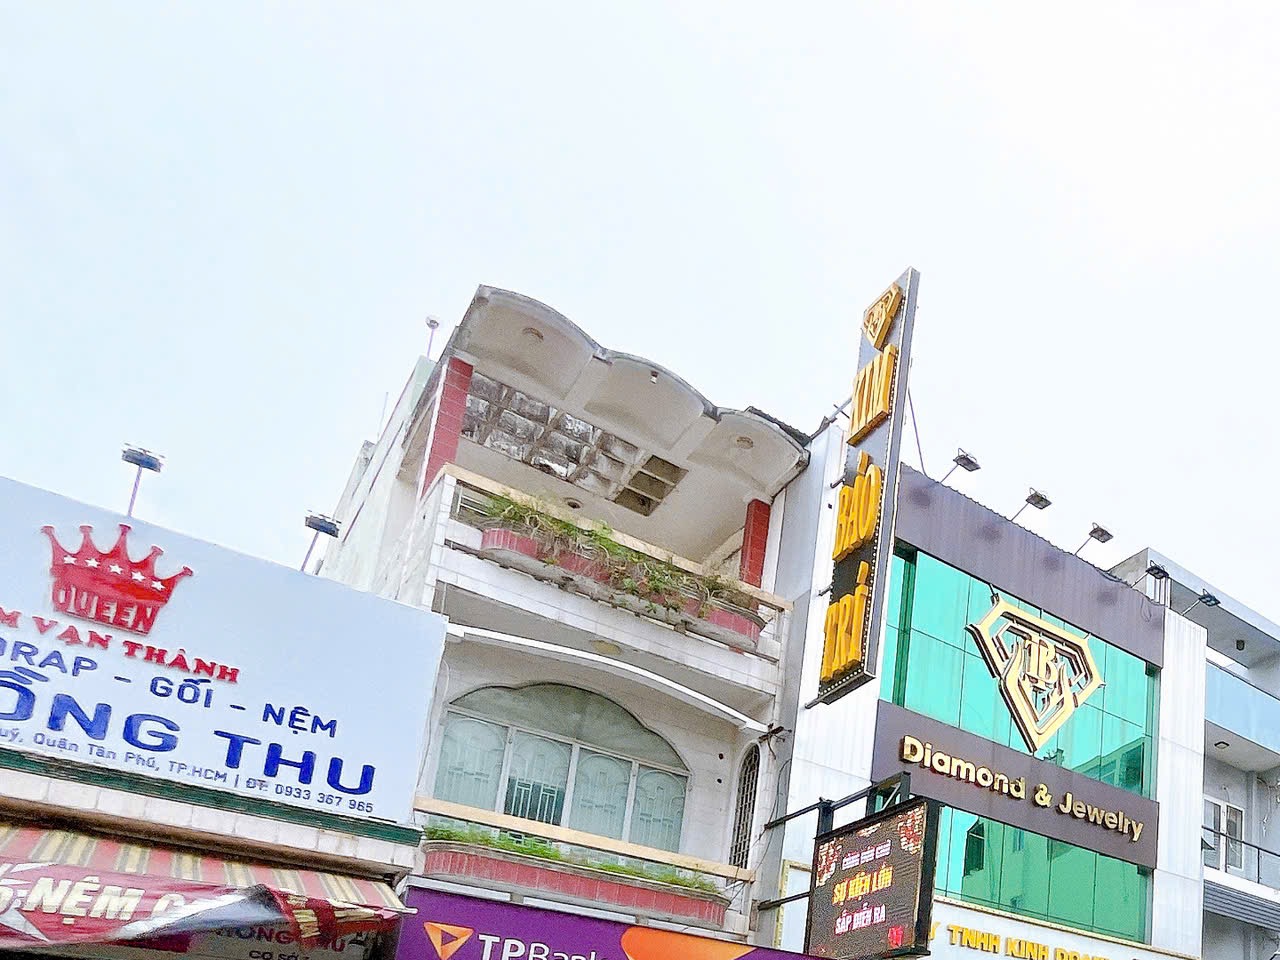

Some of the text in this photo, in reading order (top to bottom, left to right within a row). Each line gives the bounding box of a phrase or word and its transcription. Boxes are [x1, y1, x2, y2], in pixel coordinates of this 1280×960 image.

[846, 342, 900, 447] KIM
[32, 616, 112, 649] VẠN
[53, 587, 157, 636] QUEEN
[263, 703, 337, 738] NỆM
[33, 732, 78, 751] Quận
[87, 743, 117, 760] Tân
[125, 752, 160, 772] Phú,
[169, 760, 228, 783] TP.HCM
[275, 784, 311, 800] 0933
[317, 793, 342, 807] 367
[348, 799, 374, 813] 965
[214, 730, 376, 795] THU
[901, 735, 1144, 842] Diamond & Jewelry
[21, 875, 146, 925] NỆM
[946, 924, 1000, 953] TNHH
